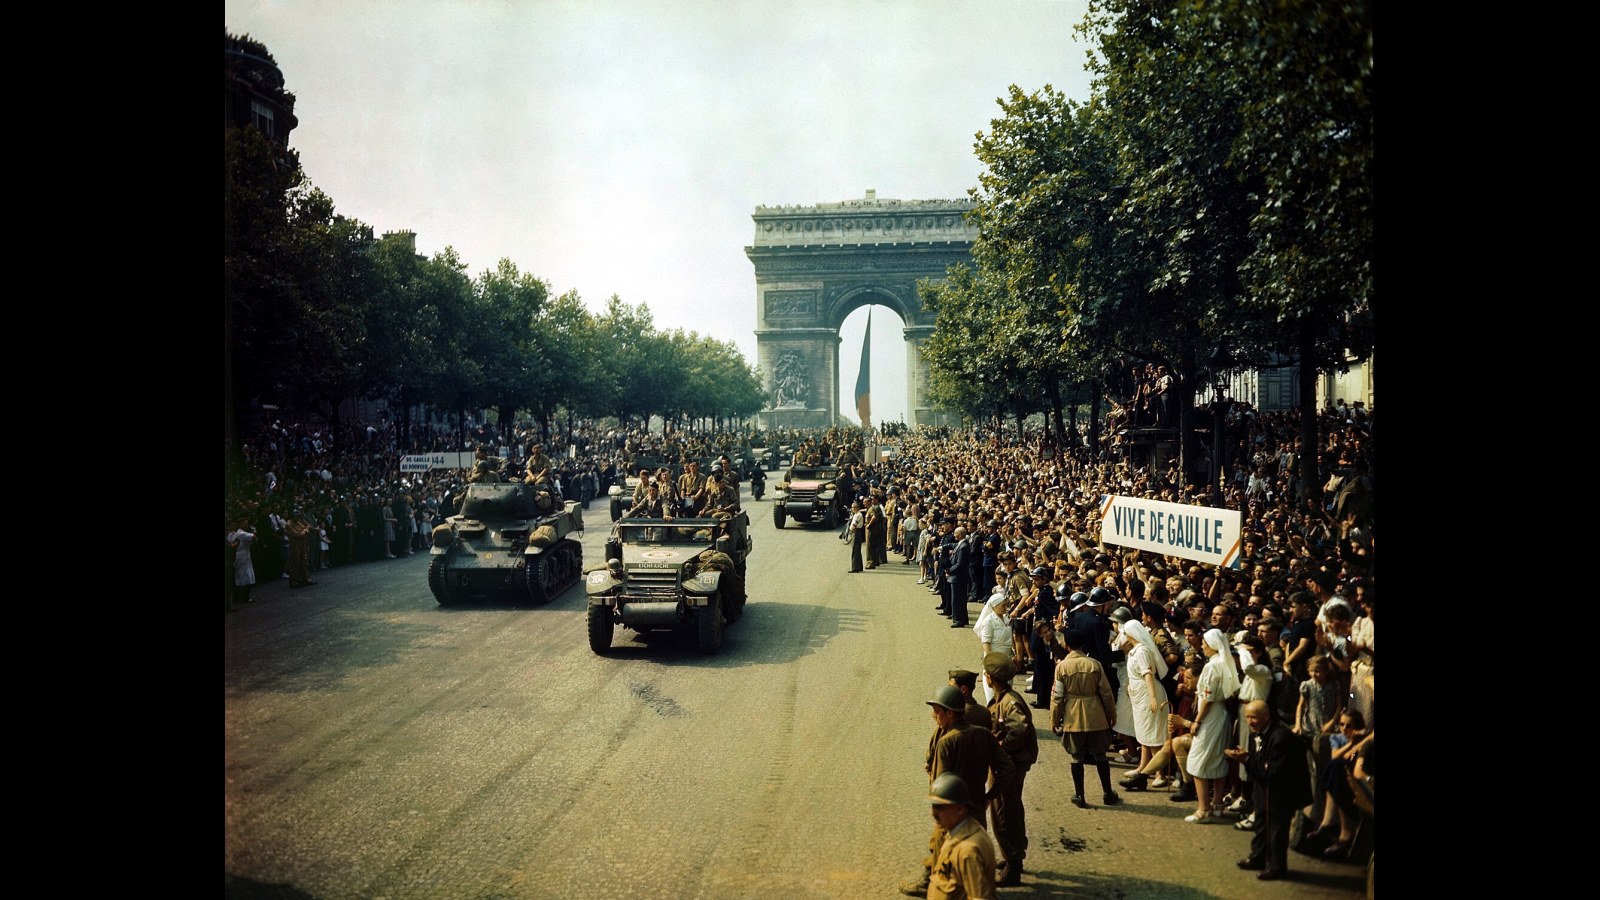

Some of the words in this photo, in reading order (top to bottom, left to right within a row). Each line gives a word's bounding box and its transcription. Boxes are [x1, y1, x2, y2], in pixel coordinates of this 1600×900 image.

[1113, 505, 1145, 541] VIVE
[1150, 510, 1164, 544] DE
[1167, 513, 1223, 555] GAULLE
